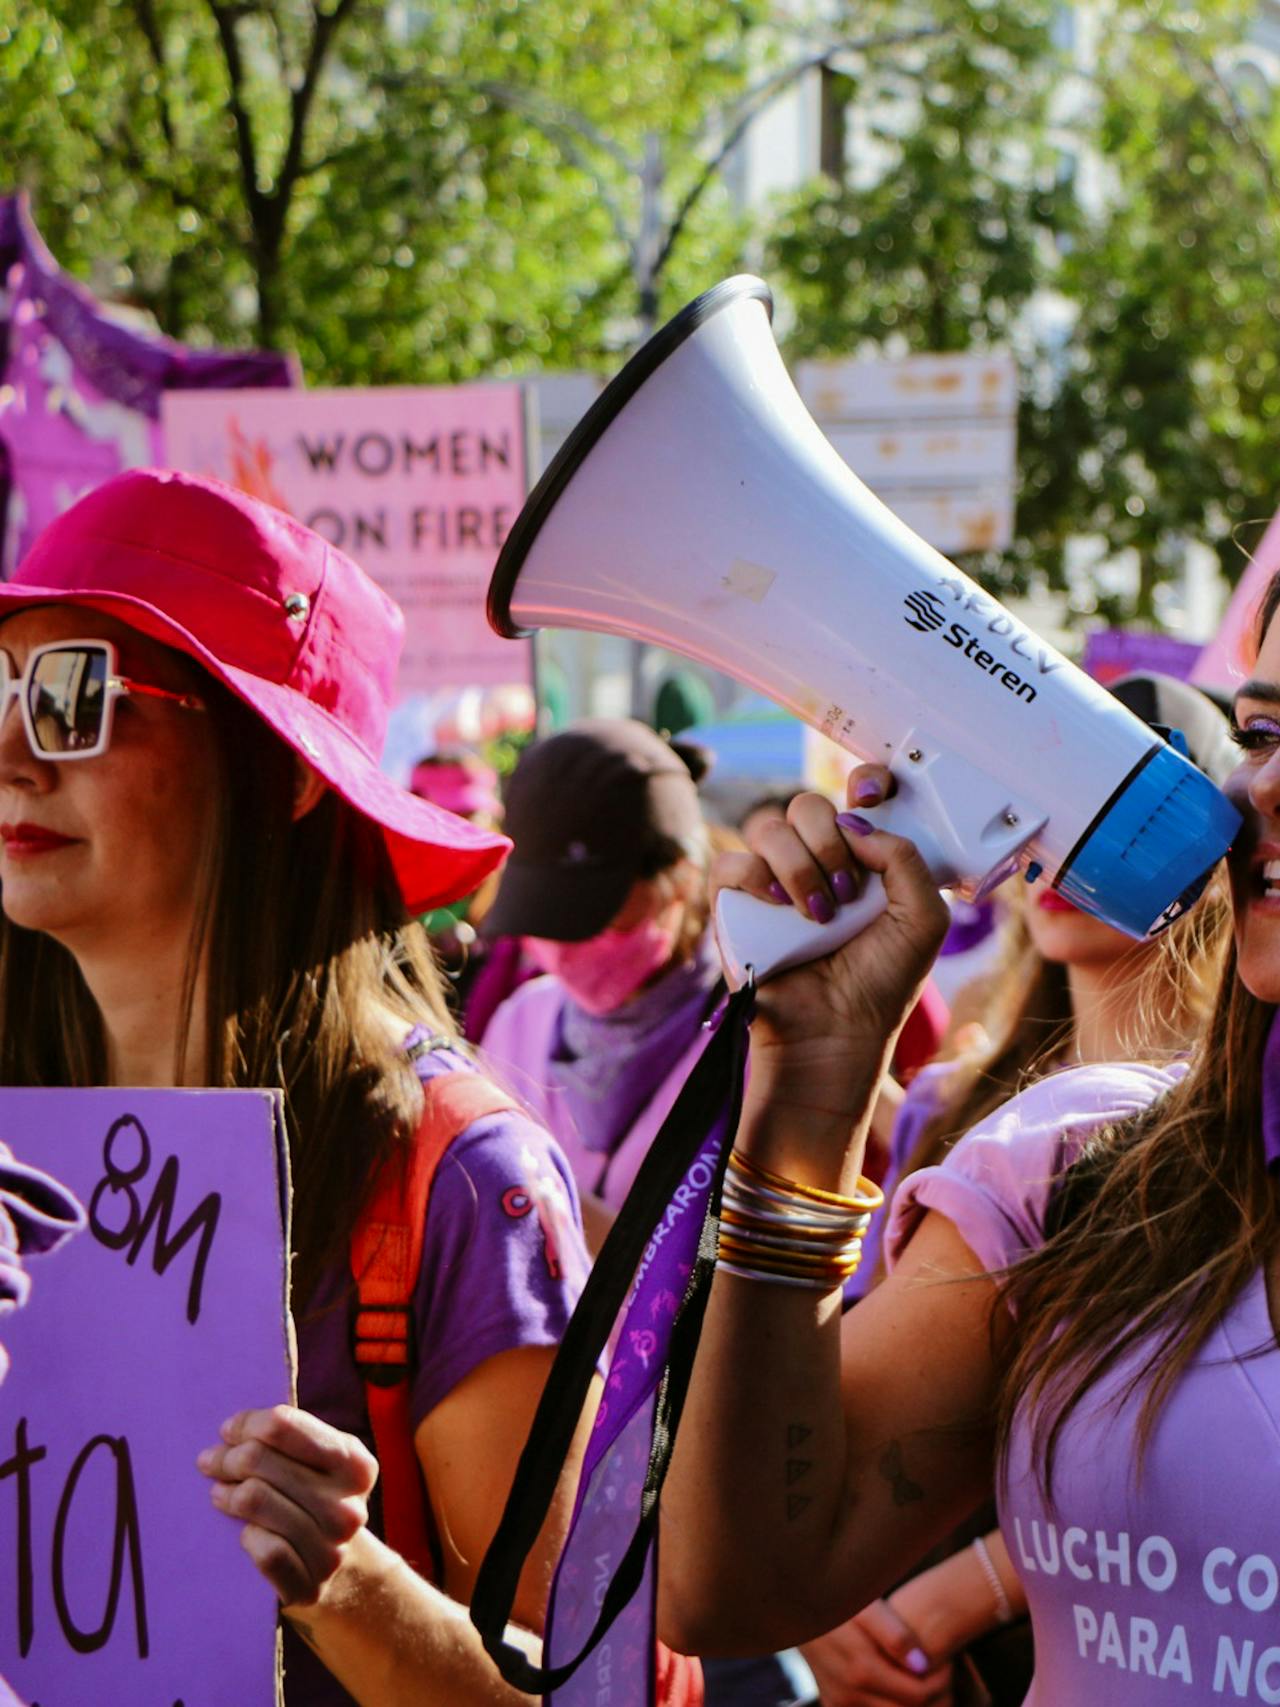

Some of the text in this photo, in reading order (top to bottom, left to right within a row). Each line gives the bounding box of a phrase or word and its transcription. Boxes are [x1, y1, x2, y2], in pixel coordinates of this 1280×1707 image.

[298, 430, 511, 475] WOMEN
[306, 506, 510, 550] ON FIRE
[942, 622, 1038, 704] Steren
[88, 1113, 222, 1325] 8M
[1013, 1517, 1177, 1592] LUCHO
[1072, 1604, 1194, 1684] PARA
